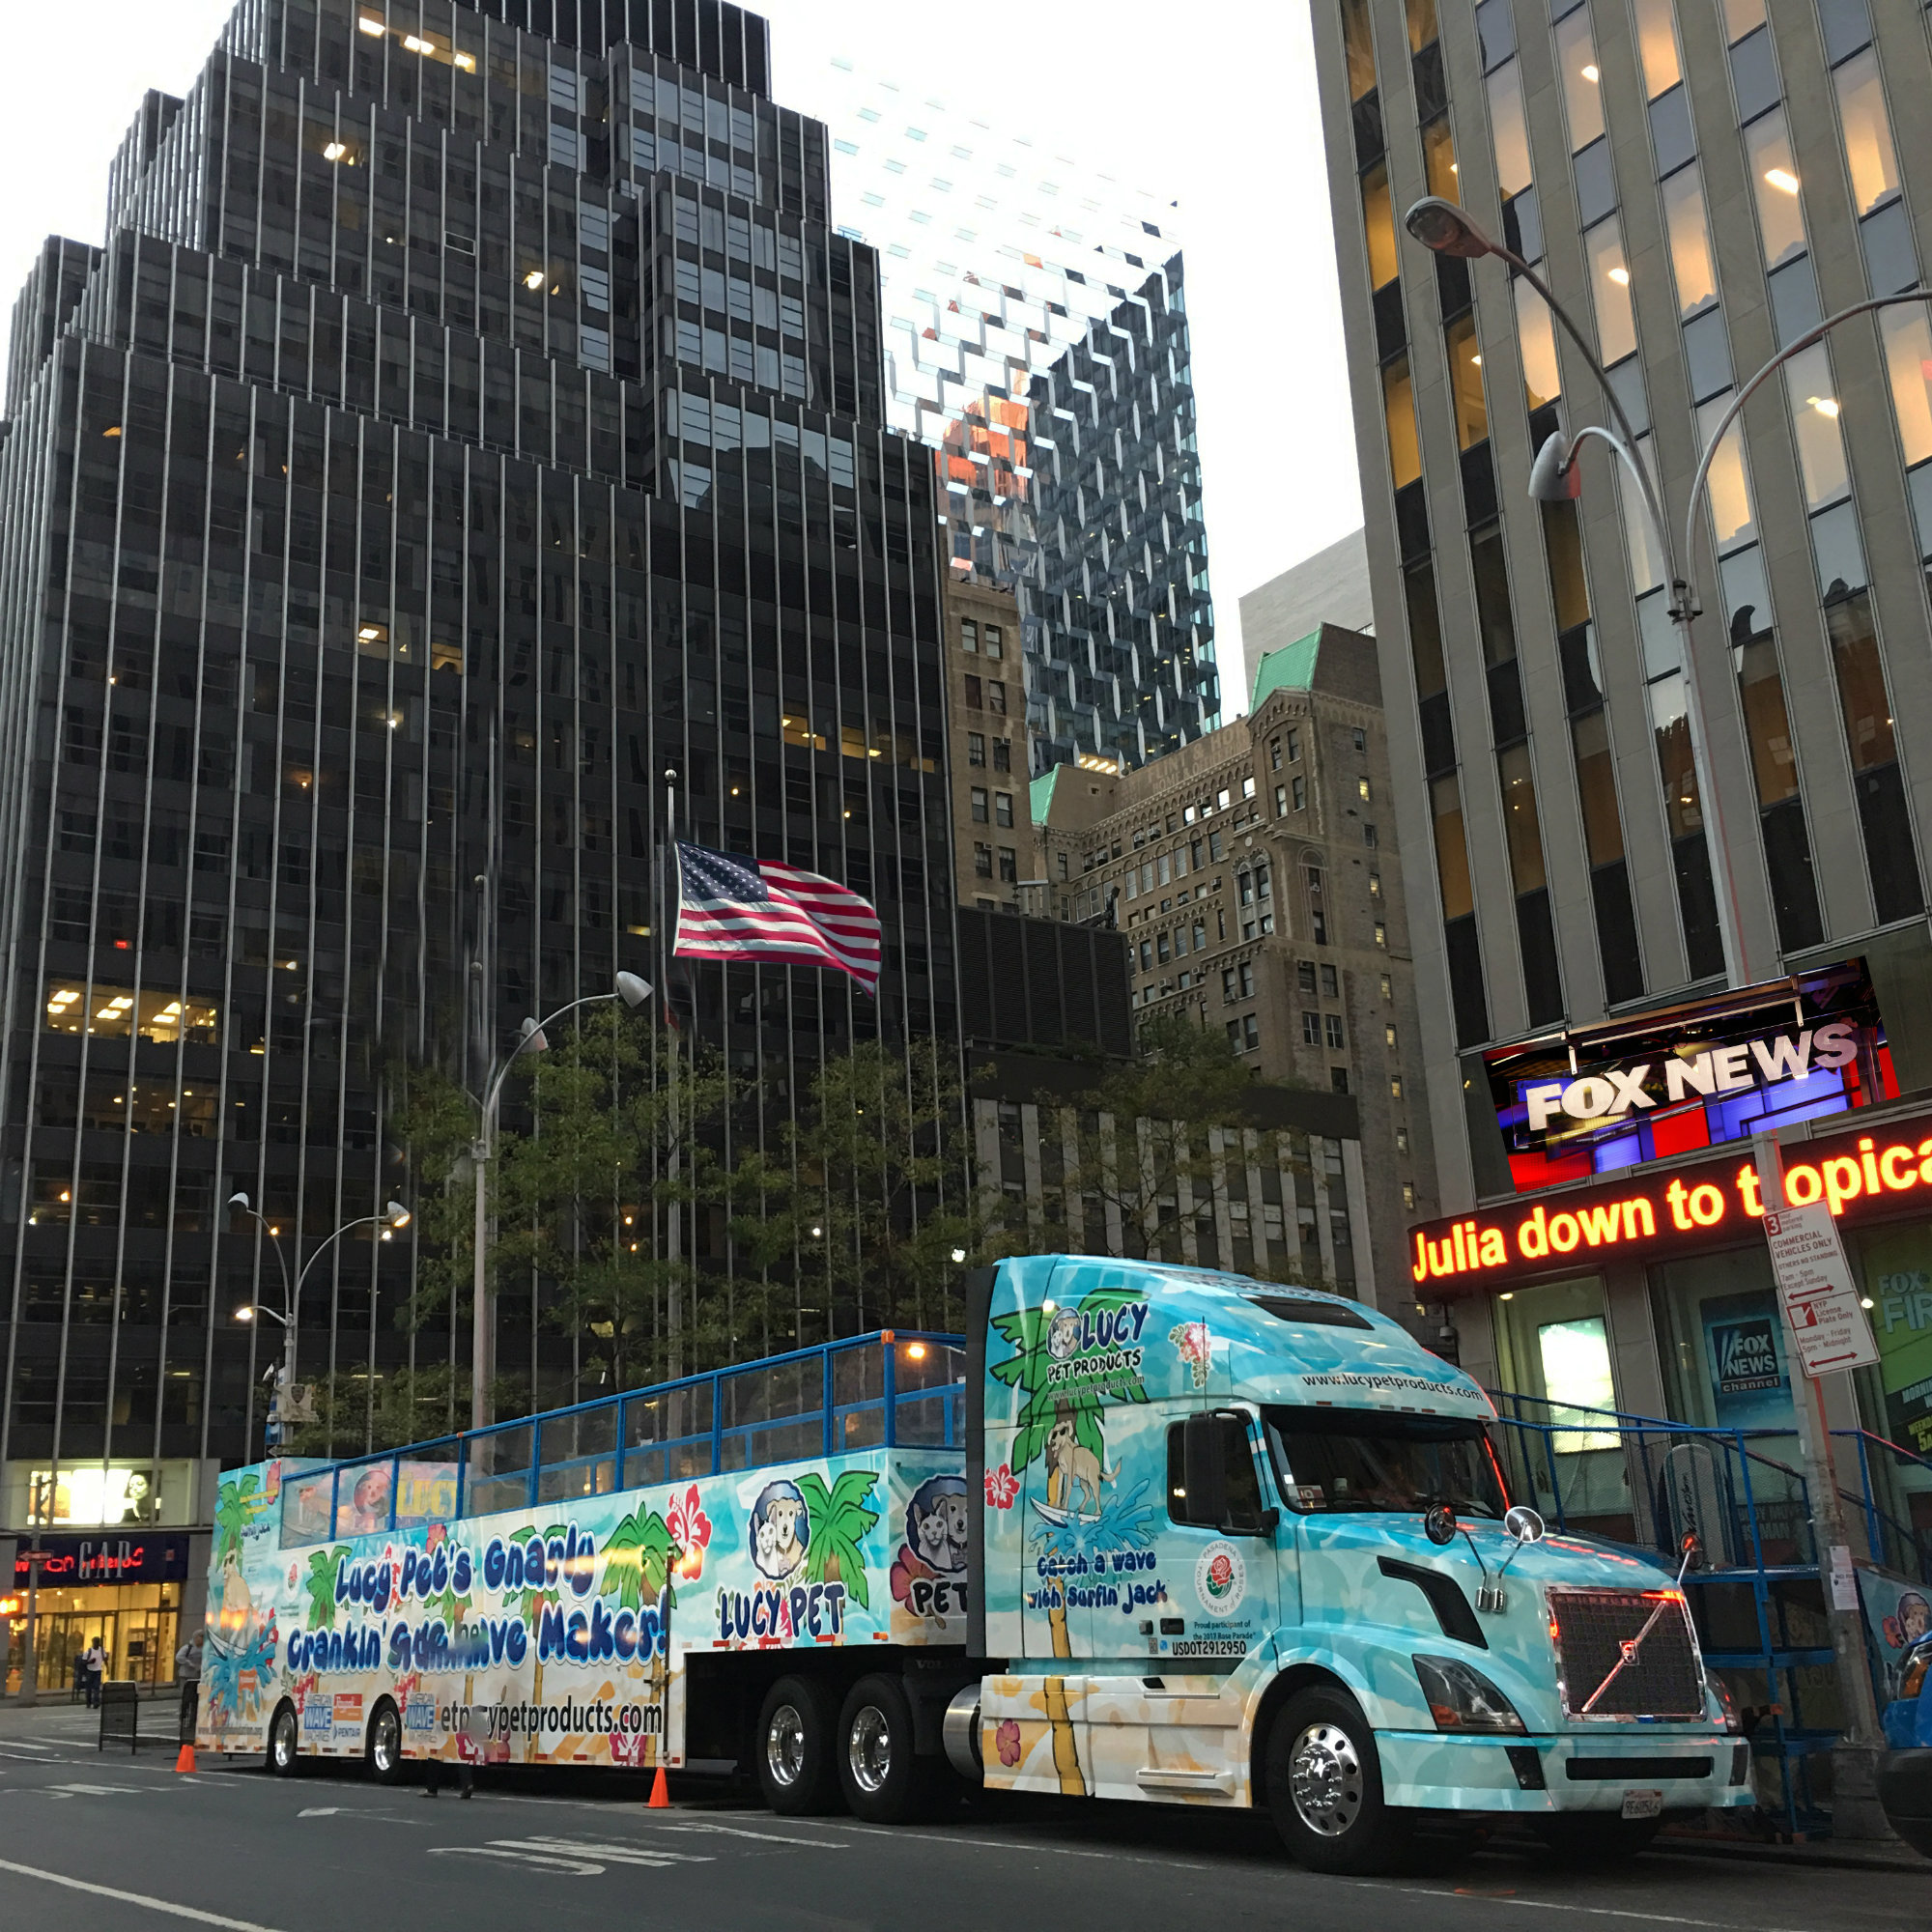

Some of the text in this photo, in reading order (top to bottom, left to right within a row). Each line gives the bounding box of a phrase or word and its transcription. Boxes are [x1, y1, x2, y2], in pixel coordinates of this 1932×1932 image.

[1525, 1022, 1859, 1131] FOX NEWS
[1412, 1218, 1508, 1282] Julia
[1518, 1196, 1657, 1258] down
[1665, 1178, 1726, 1232] to
[1767, 1216, 1779, 1235] 3
[1773, 1231, 1823, 1249] COMMERCIAL
[1776, 1237, 1833, 1259] VEHICLES ONLY
[1777, 1259, 1801, 1270] OTHERS
[1809, 1250, 1838, 1263] STANDING
[1783, 1275, 1828, 1291] Except Sunday
[1799, 1268, 1814, 1278] 5pm
[1878, 1270, 1924, 1295] FOX
[1813, 1300, 1828, 1310] NYP
[1816, 1306, 1842, 1318] License
[1081, 1302, 1150, 1351] LUCY
[1818, 1310, 1854, 1325] Plate Only
[1733, 1334, 1773, 1356] FOX
[1799, 1333, 1825, 1344] Monday
[1831, 1327, 1851, 1337] Friday
[1802, 1344, 1818, 1353] 5pm
[1823, 1336, 1852, 1348] Midnight
[1047, 1348, 1143, 1383] PET PRODUCTS
[1725, 1354, 1776, 1378] NEWS
[1047, 1375, 1146, 1401] www.lucypetproducts.com
[1301, 1374, 1484, 1402] www.lucypetproducts.com
[1722, 1377, 1779, 1392] channel
[78, 1540, 130, 1579] GAP
[1203, 1542, 1237, 1558] PASADENA
[335, 1553, 391, 1614] Lucy
[399, 1539, 472, 1601] Pet's
[484, 1520, 596, 1597] Gnarly
[1037, 1548, 1157, 1577] Catch a wave
[912, 1580, 967, 1614] PET
[1027, 1578, 1169, 1615] with Surfin' Jack
[1196, 1566, 1229, 1613] TOURNAMENT
[1236, 1564, 1244, 1600] ROSES
[721, 1583, 845, 1640] LUCY PET
[538, 1590, 667, 1663] Maker!
[1203, 1632, 1217, 1640] 2017
[1217, 1632, 1232, 1640] Rose
[1211, 1620, 1243, 1631] participant
[1243, 1619, 1251, 1628] of
[287, 1620, 387, 1672] Crankin'
[1172, 1640, 1247, 1656] USDOT2912950
[305, 1707, 331, 1728] WAVE
[408, 1706, 434, 1728] WAVE
[337, 1727, 361, 1738] PENTAIR
